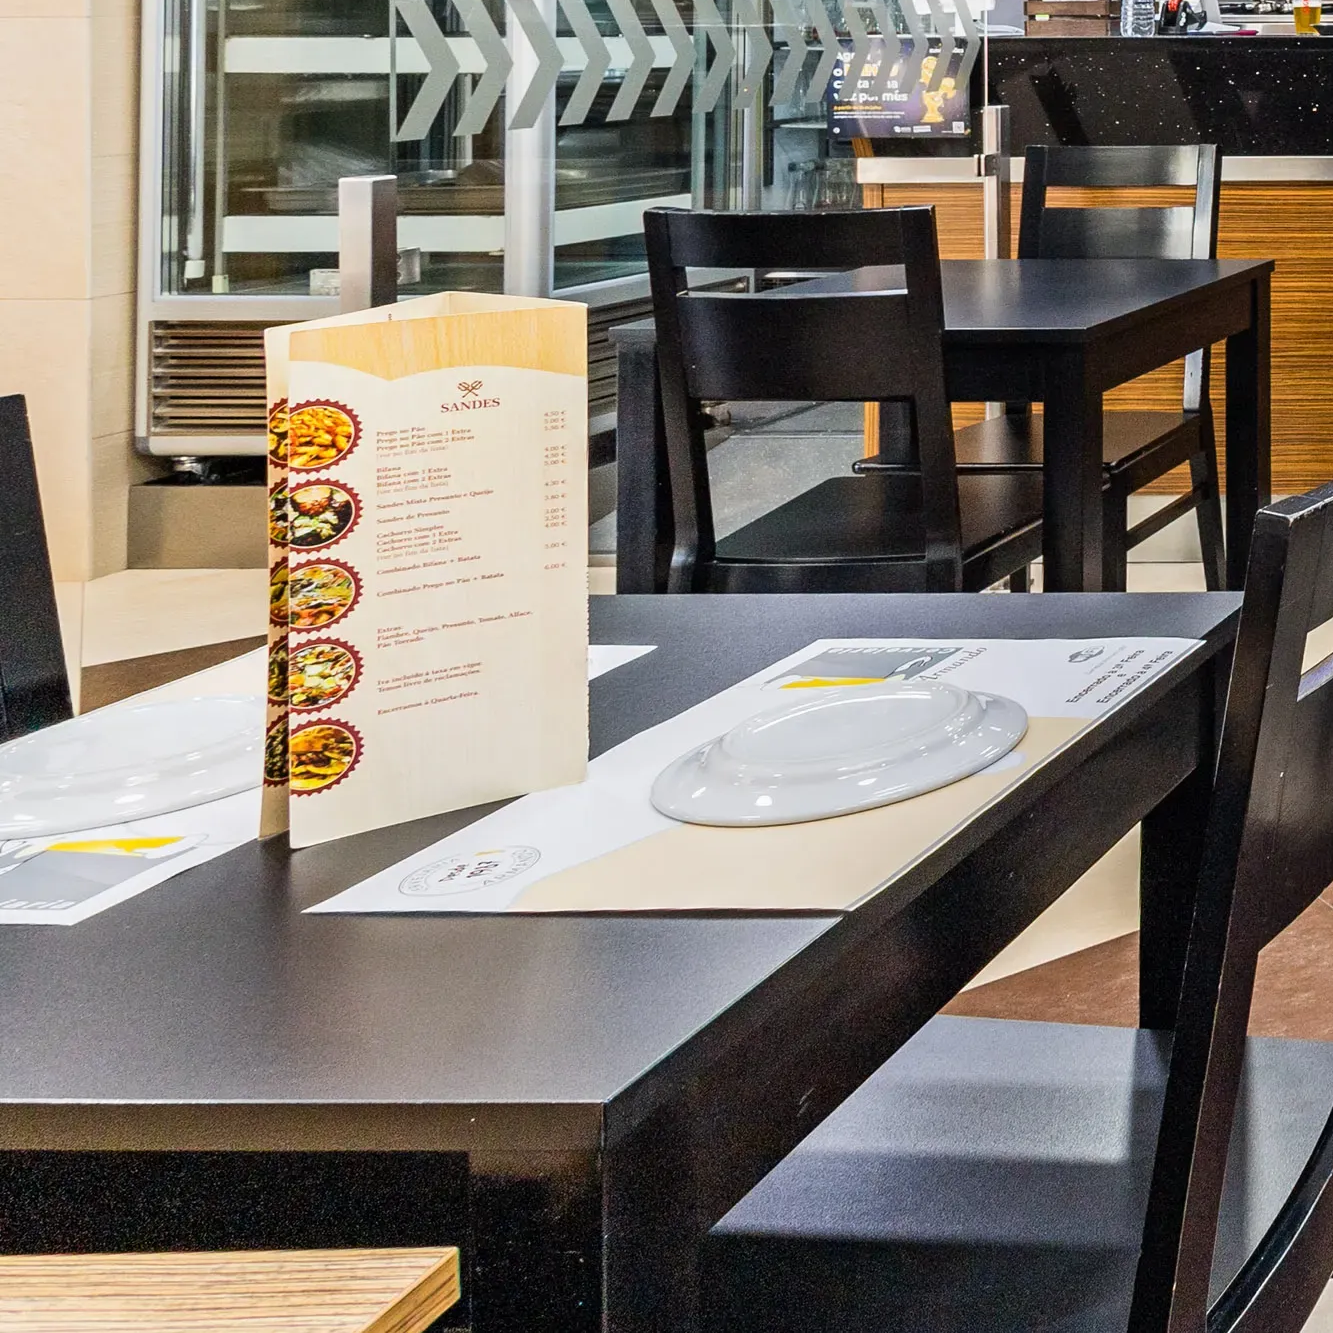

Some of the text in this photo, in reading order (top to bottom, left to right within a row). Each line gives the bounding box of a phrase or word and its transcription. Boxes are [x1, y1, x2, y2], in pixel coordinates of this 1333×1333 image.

[440, 397, 501, 413] SANDES
[376, 530, 413, 539] Cachorro
[376, 538, 413, 546] Cachorro
[376, 545, 413, 553] Cachorro
[376, 565, 421, 575] Combinado
[376, 586, 421, 597] Combinado
